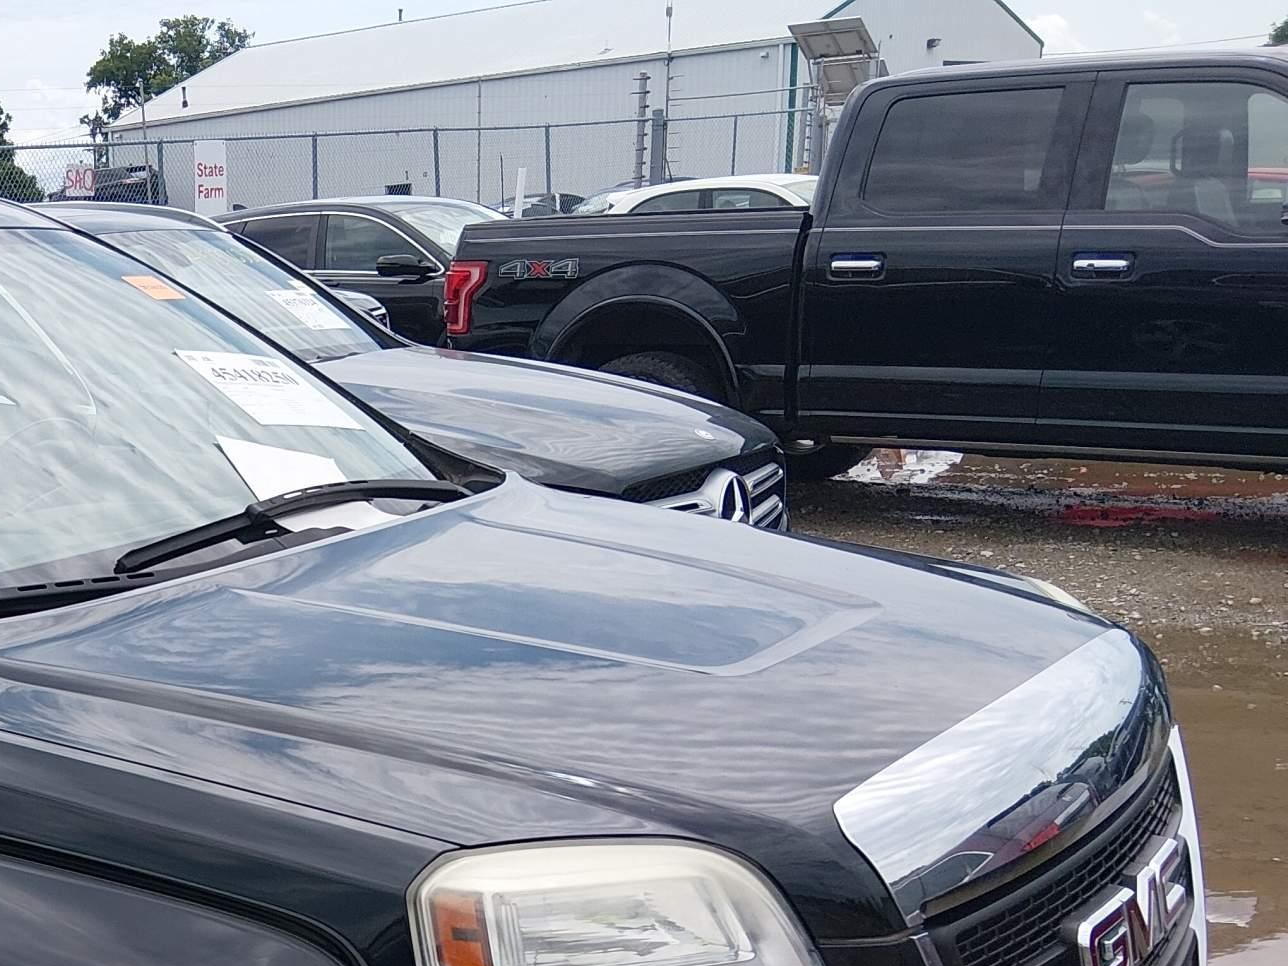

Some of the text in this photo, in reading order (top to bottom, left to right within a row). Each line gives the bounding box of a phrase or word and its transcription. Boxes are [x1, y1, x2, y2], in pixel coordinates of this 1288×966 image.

[196, 163, 225, 178] State
[197, 184, 225, 199] Farm
[211, 367, 300, 386] 45418250
